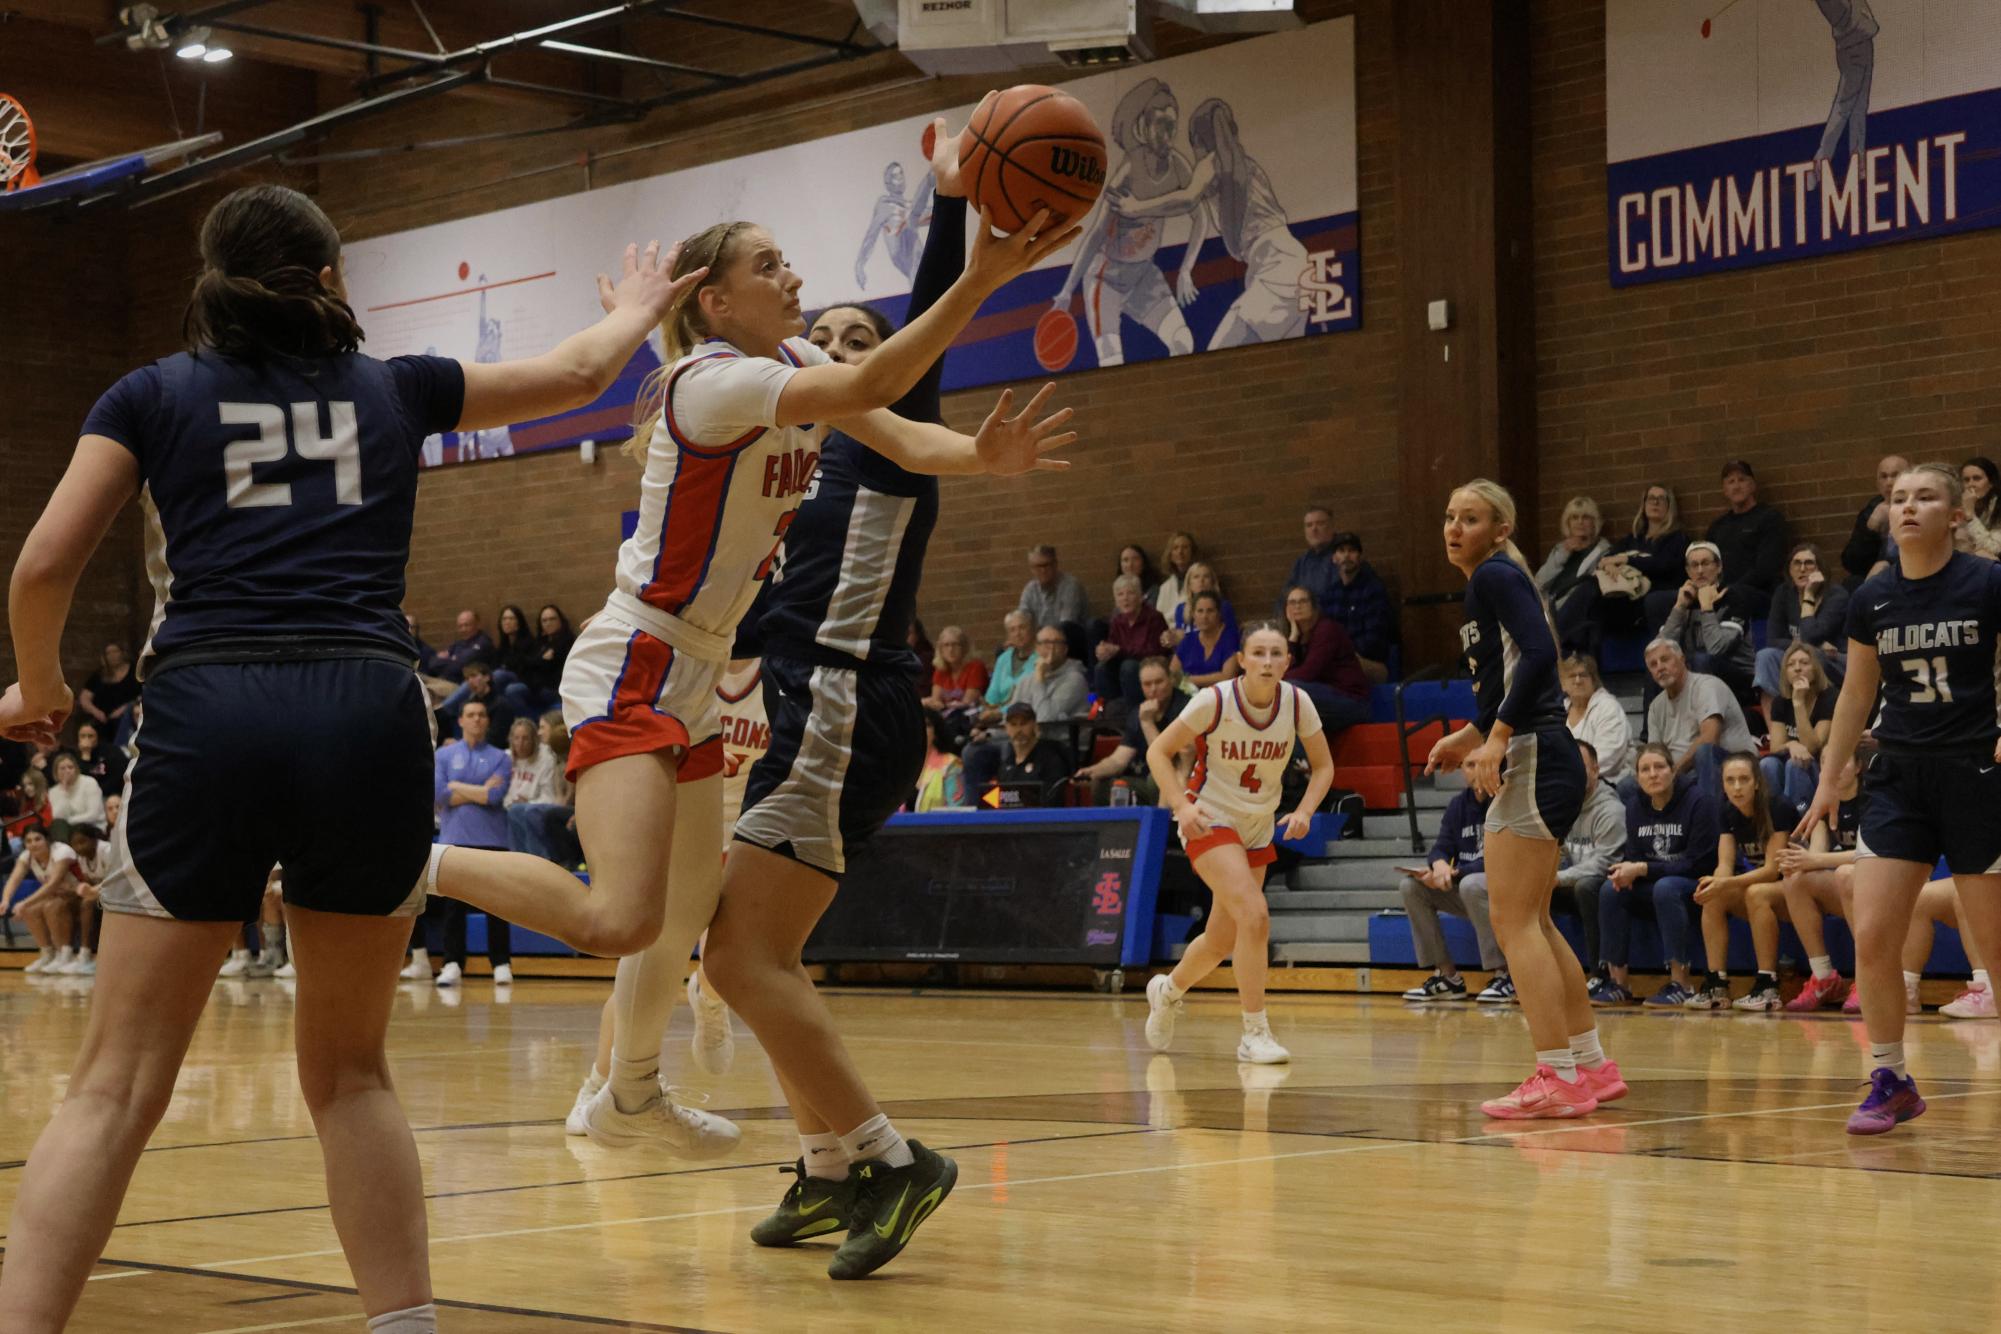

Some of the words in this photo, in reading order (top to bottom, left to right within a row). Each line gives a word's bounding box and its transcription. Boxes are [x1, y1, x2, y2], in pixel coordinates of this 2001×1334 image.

[1618, 131, 1967, 273] COMMITMENT
[218, 400, 363, 509] 24
[1876, 620, 1980, 656] WILDCATS
[1901, 656, 1954, 703] 31
[1221, 741, 1289, 760] FALCONS
[1240, 764, 1262, 794] 4
